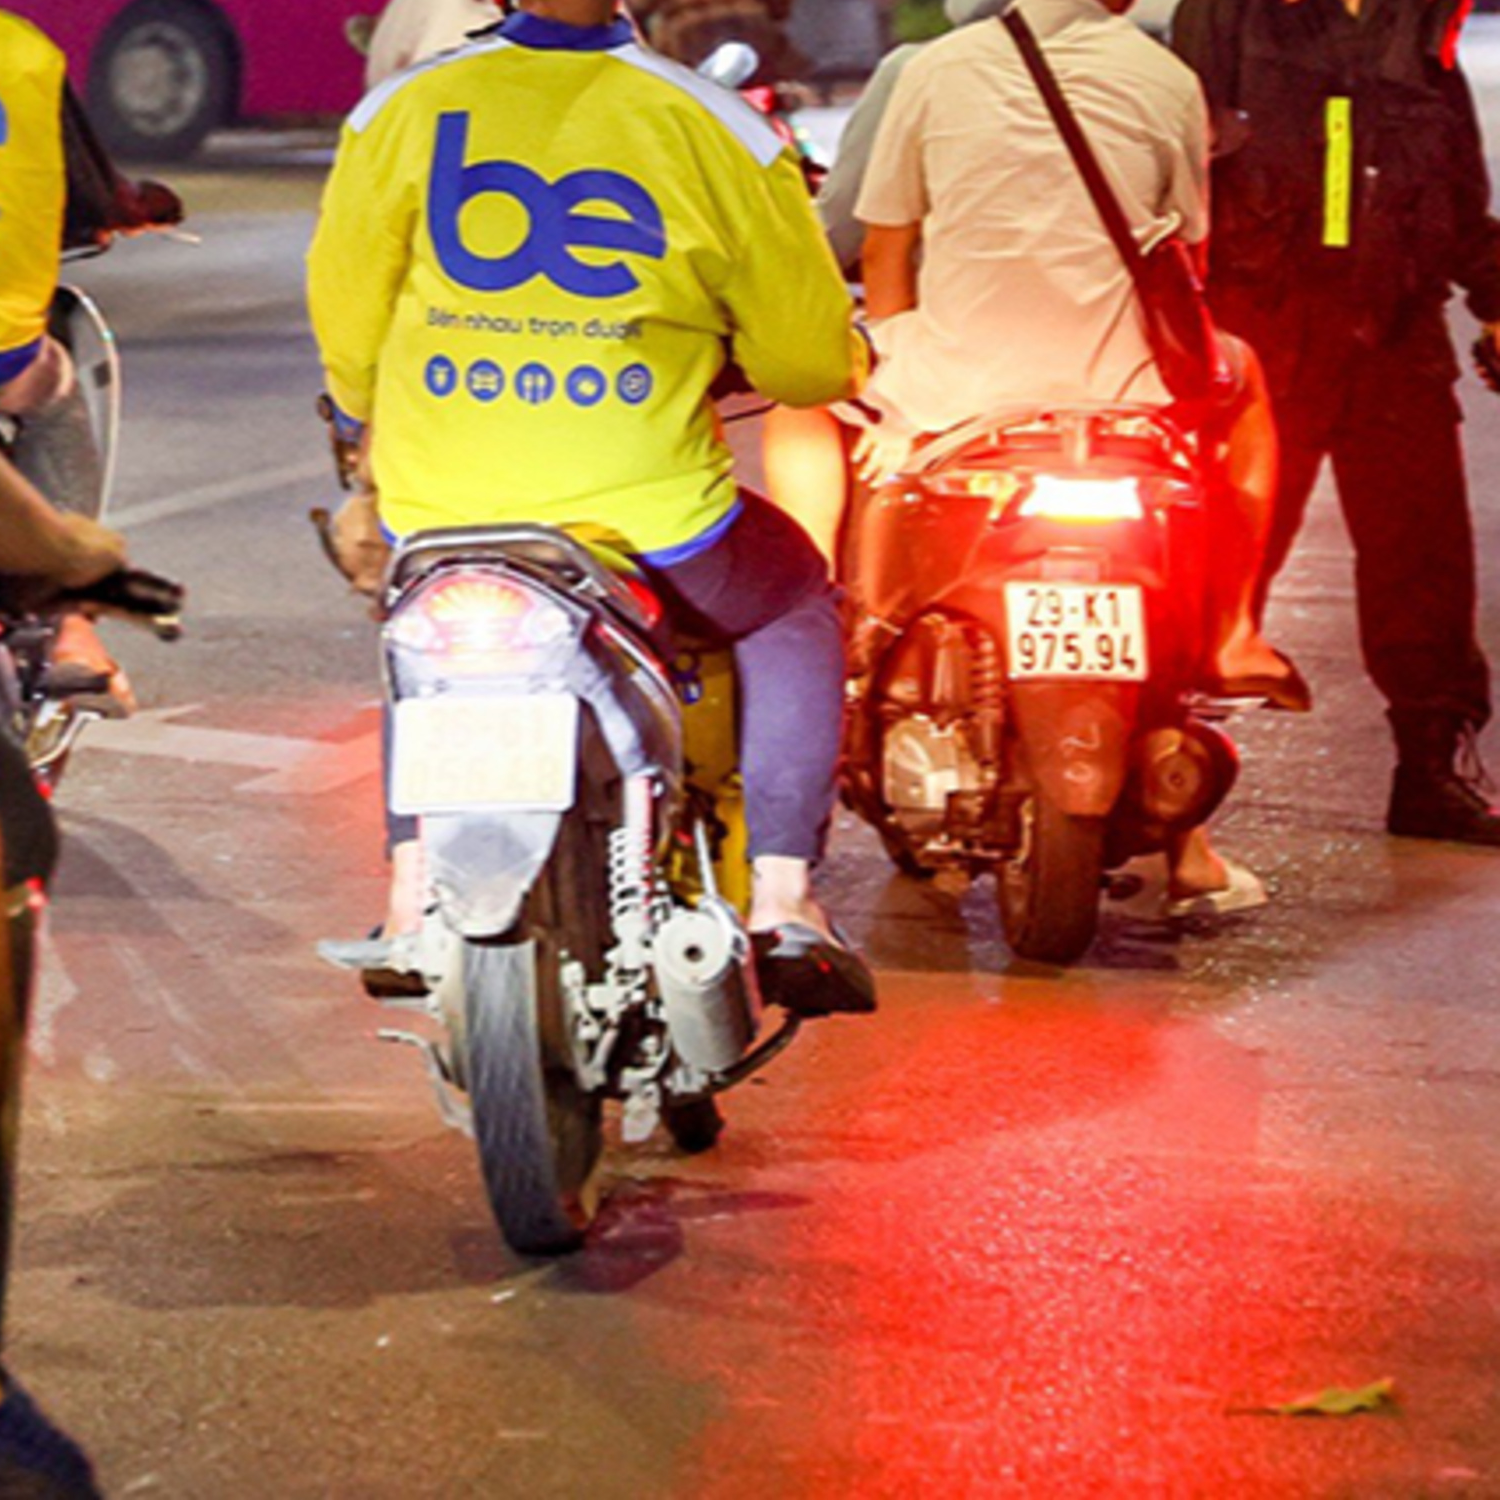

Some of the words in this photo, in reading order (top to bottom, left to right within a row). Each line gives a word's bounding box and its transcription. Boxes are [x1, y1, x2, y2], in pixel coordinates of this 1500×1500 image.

[427, 111, 667, 298] be
[1026, 589, 1121, 628] 29-K1
[1018, 632, 1137, 672] 975.94
